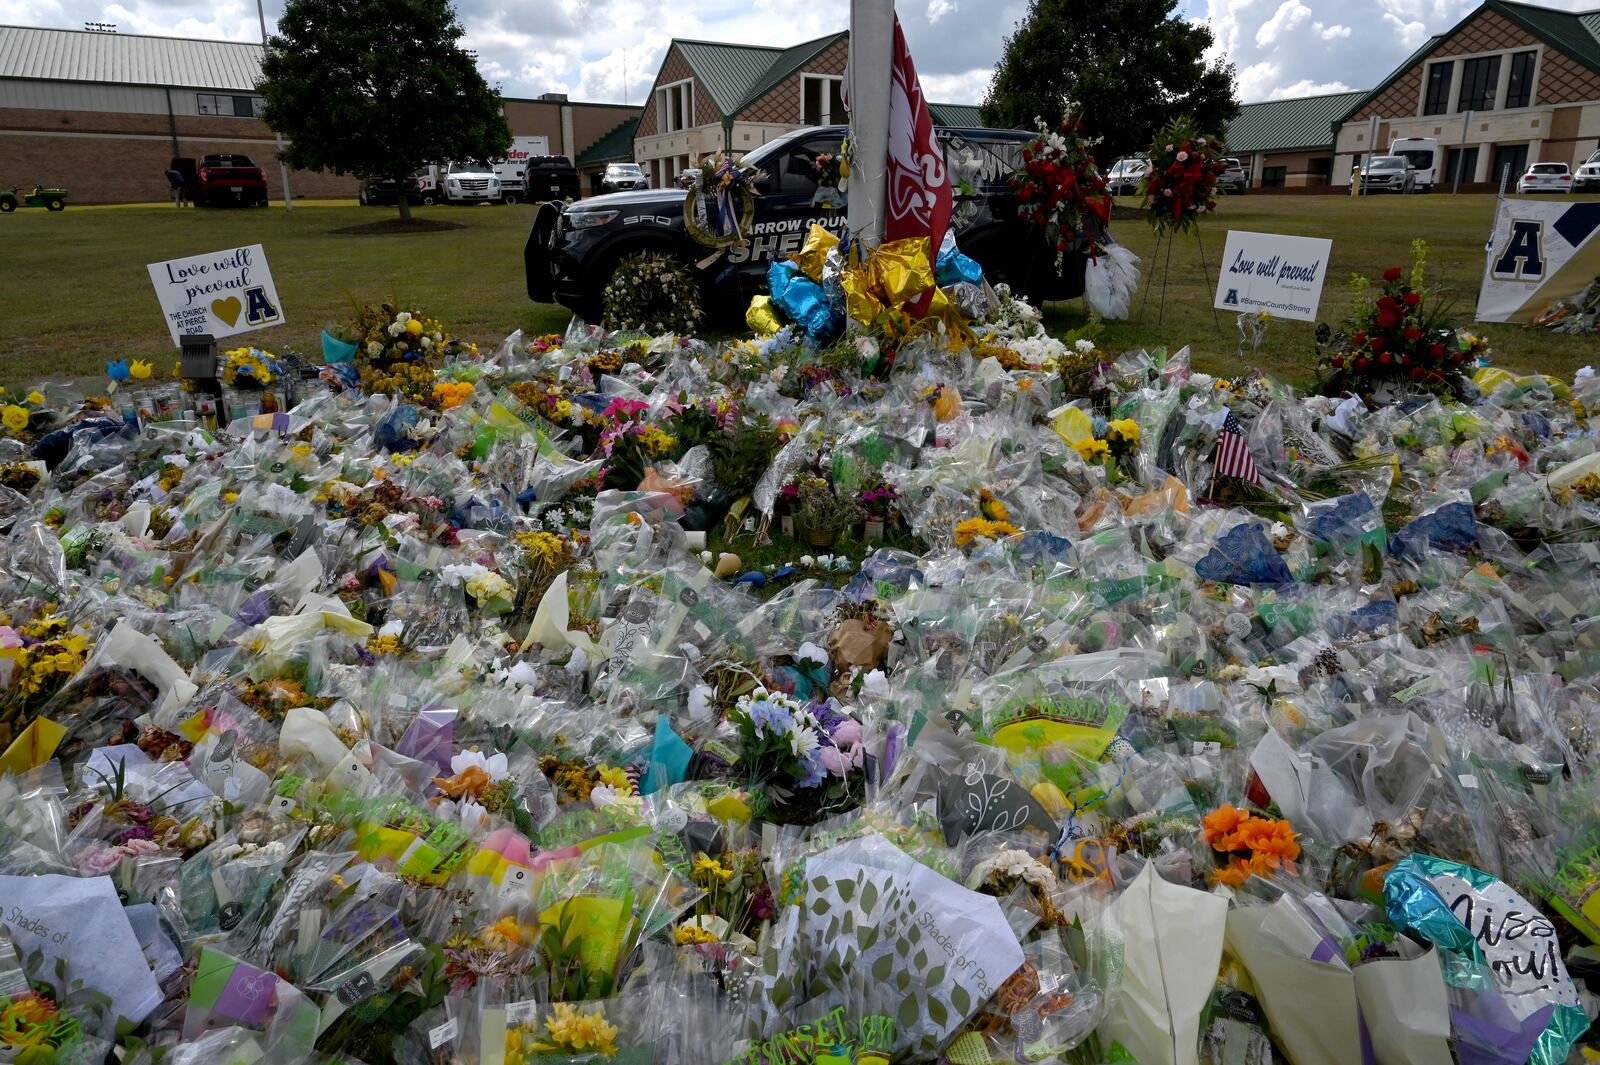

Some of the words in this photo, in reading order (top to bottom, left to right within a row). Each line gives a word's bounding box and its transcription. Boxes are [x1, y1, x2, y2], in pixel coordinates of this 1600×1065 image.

[508, 149, 529, 159] der
[624, 215, 671, 226] SRO
[746, 219, 802, 235] ARROW
[805, 215, 849, 230] COUN
[166, 263, 210, 284] Love
[213, 248, 252, 270] will
[1229, 249, 1254, 275] Love
[1256, 255, 1280, 278] will
[1276, 260, 1320, 285] prevail
[185, 267, 251, 305] prevail
[169, 312, 182, 321] THE
[182, 307, 208, 319] CHURCH
[1240, 297, 1311, 314] #BarrowCountyStrong
[177, 320, 185, 328] AT
[185, 315, 207, 327] PIERCE
[186, 325, 203, 335] ROAD
[6, 906, 50, 938] Shades
[52, 931, 70, 944] of
[918, 912, 957, 957] Shades
[956, 956, 977, 970] of
[970, 968, 994, 997] Pas
[1492, 941, 1559, 987] ou!
